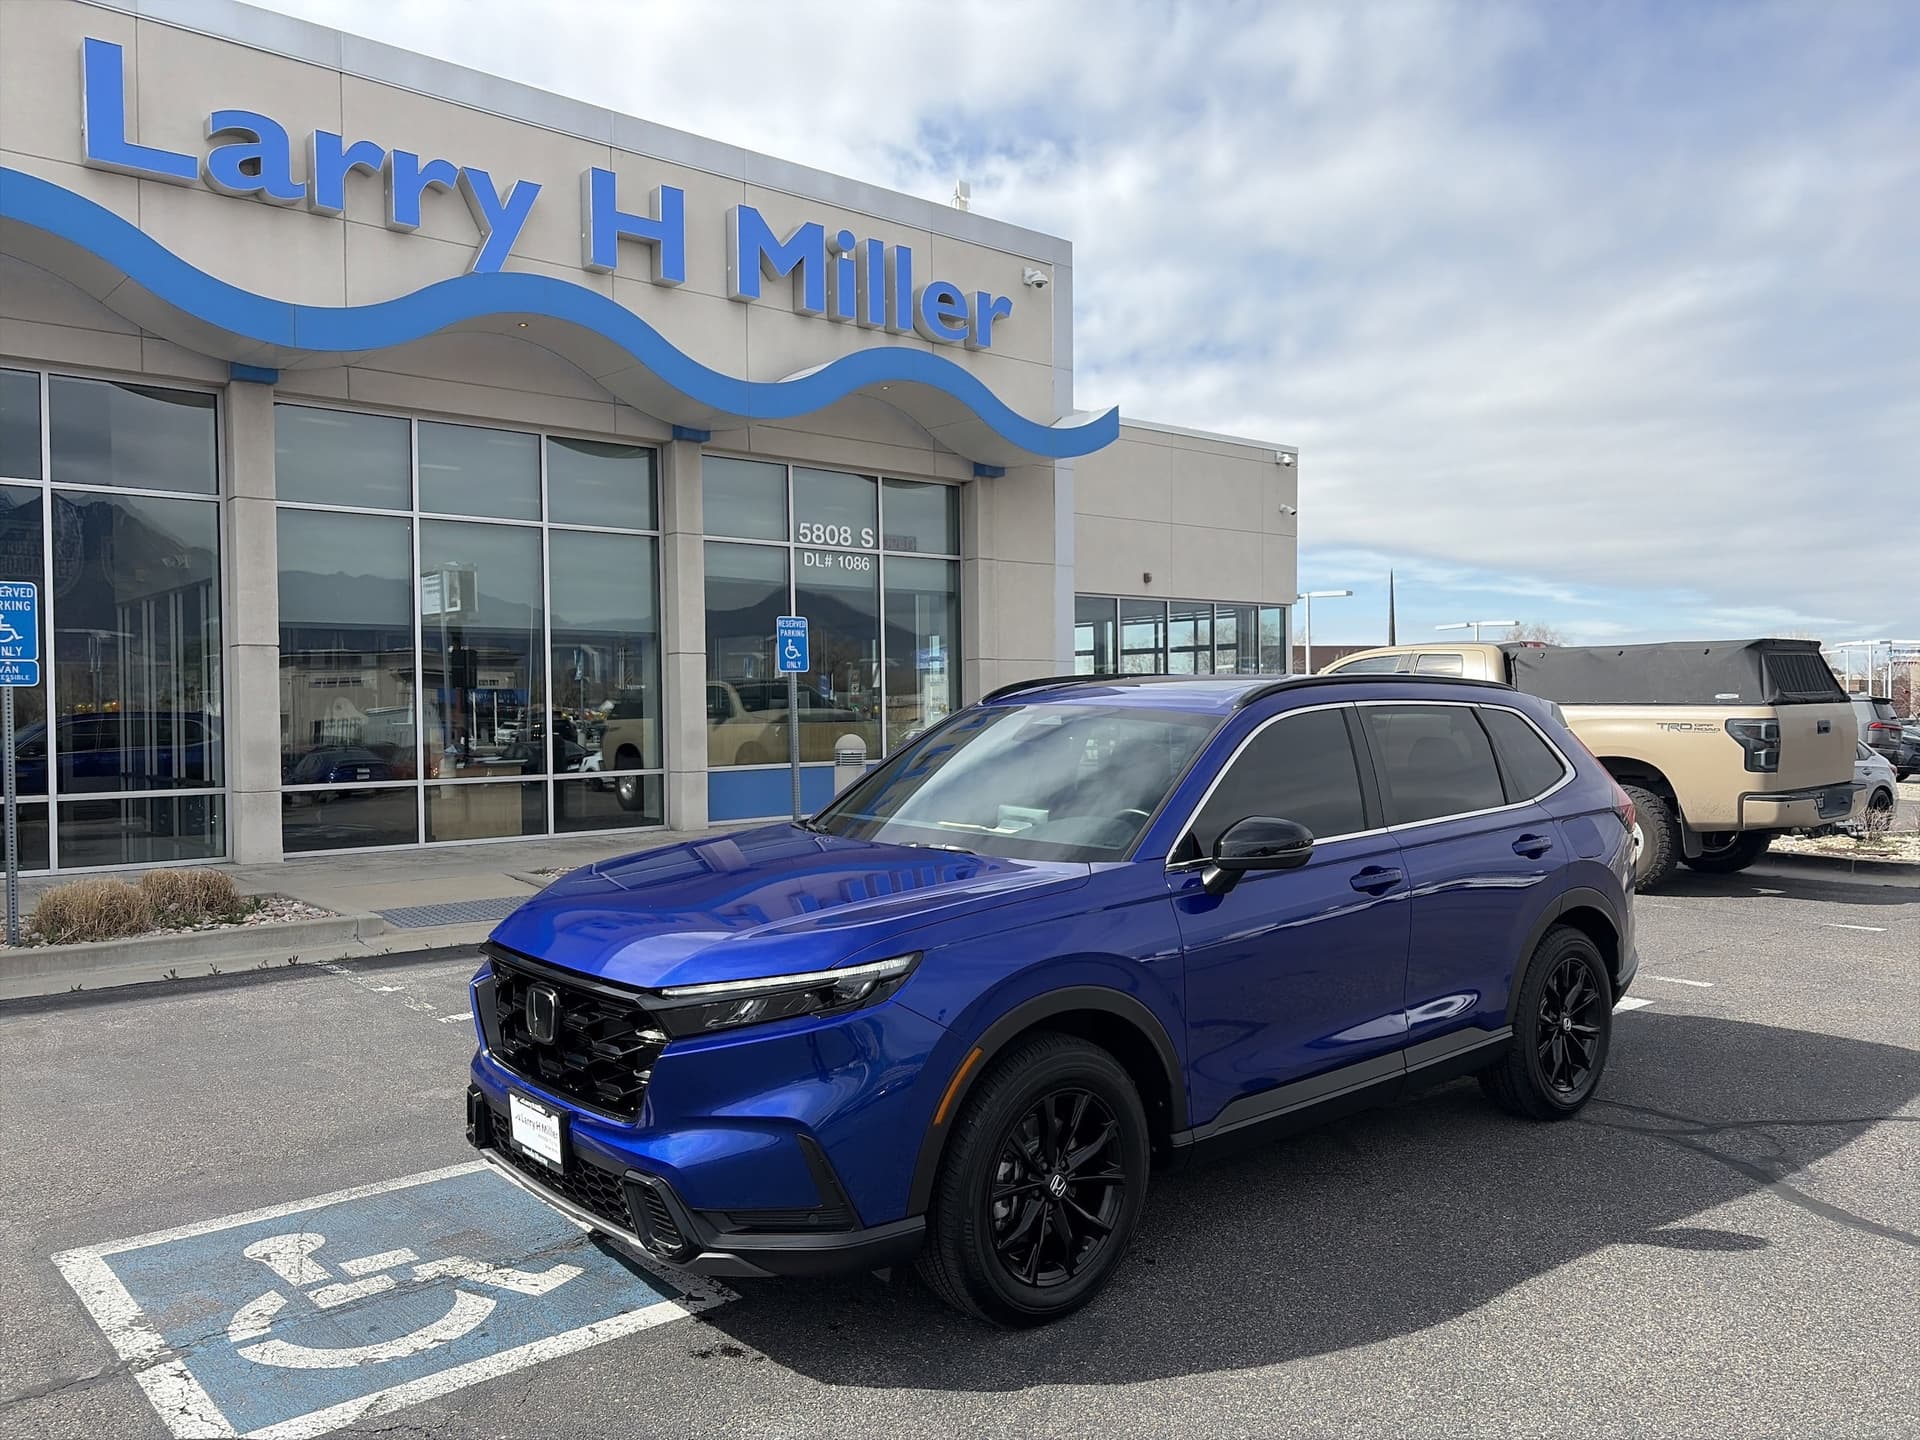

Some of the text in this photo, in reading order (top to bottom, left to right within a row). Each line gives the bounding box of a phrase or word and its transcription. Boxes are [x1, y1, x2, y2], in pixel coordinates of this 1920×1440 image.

[80, 36, 1013, 350] Larry H Miller
[799, 522, 851, 546] 5808
[860, 527, 874, 548] S
[804, 552, 870, 571] DL# 1086
[778, 620, 806, 628] RESERVED
[780, 629, 805, 638] PARKING
[786, 660, 801, 669] ONLY
[1656, 723, 1692, 732] TRD
